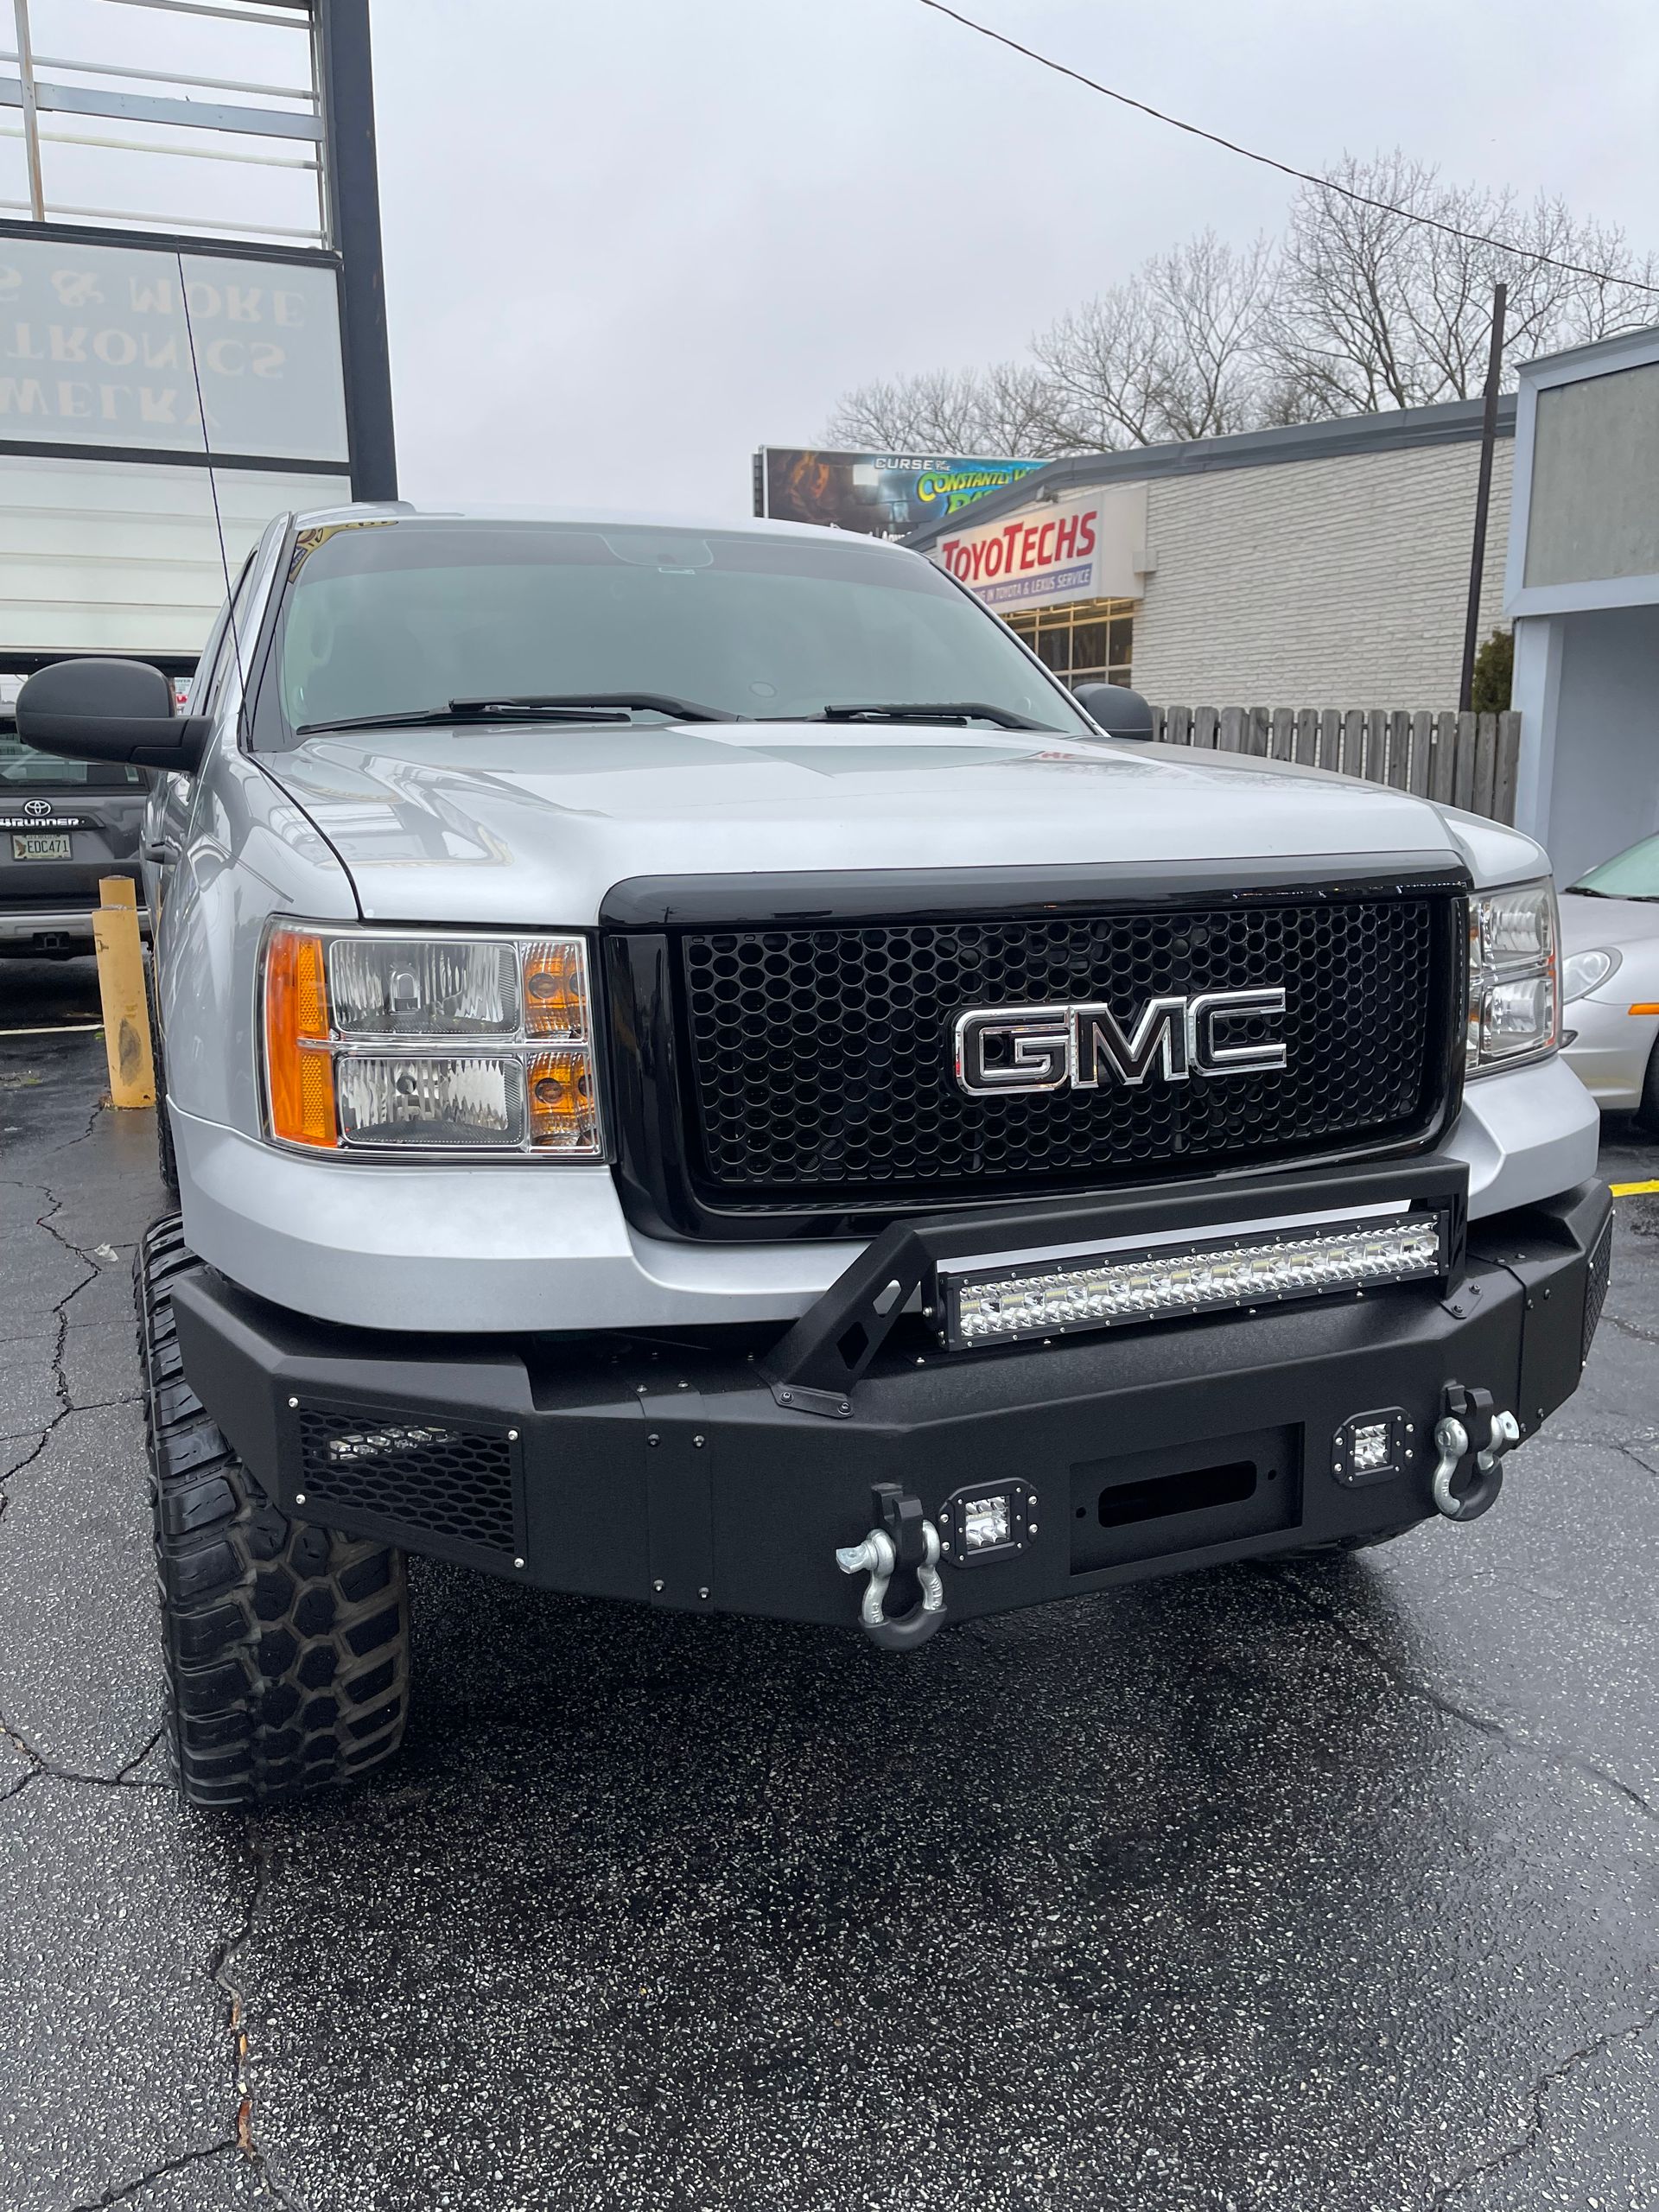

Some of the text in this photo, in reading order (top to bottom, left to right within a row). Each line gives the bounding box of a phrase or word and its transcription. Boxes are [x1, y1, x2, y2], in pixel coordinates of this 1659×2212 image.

[875, 458, 932, 470] CURSE
[918, 472, 1010, 502] CONSTANTLY
[995, 582, 1021, 600] TOYOTA
[1023, 582, 1029, 594] &
[1031, 576, 1055, 594] LEXUS
[1057, 569, 1090, 588] SERVICE
[27, 840, 69, 854] EDC471
[956, 988, 1287, 1096] GMC
